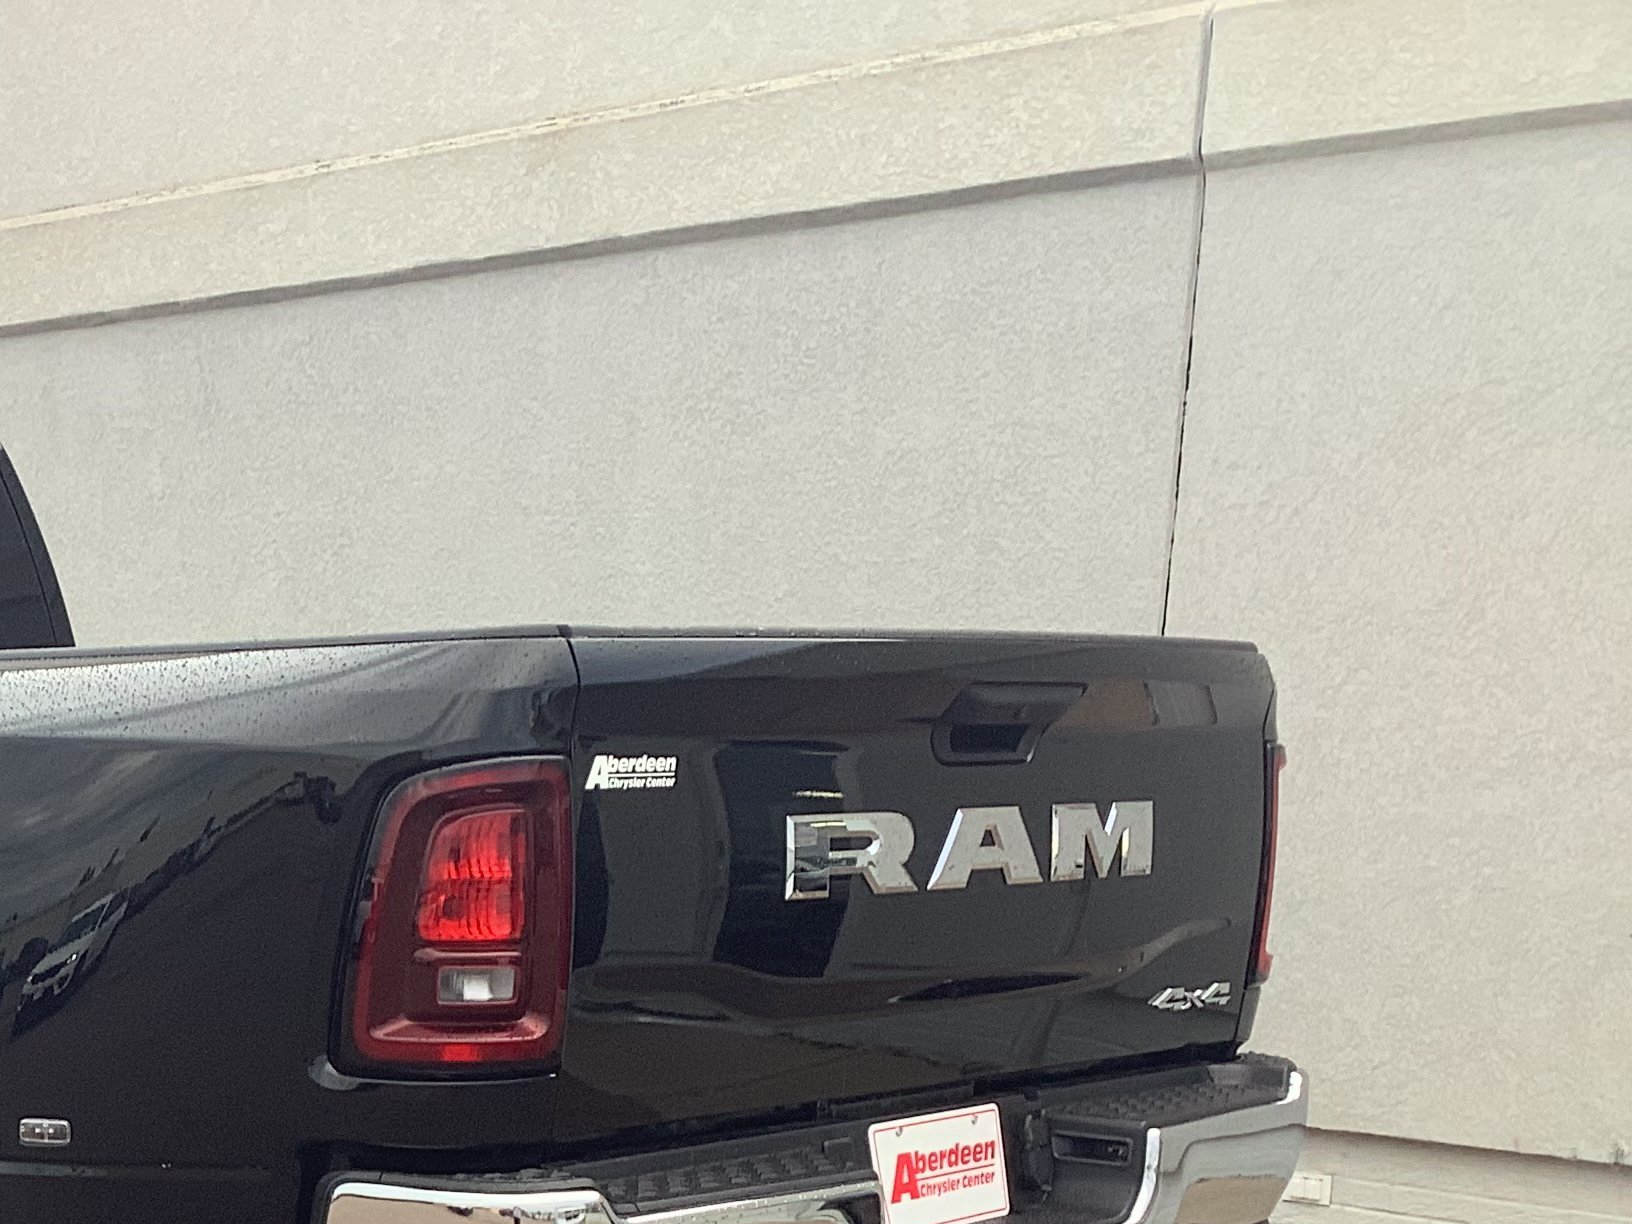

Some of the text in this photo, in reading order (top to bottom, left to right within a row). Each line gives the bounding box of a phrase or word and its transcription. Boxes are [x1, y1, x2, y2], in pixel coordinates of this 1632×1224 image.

[585, 754, 677, 790] Aberdeen
[609, 777, 676, 790] Chrysler Center
[785, 800, 1154, 900] RAM
[891, 1140, 995, 1204] Aberdeen
[919, 1171, 995, 1197] Chrysler Center
